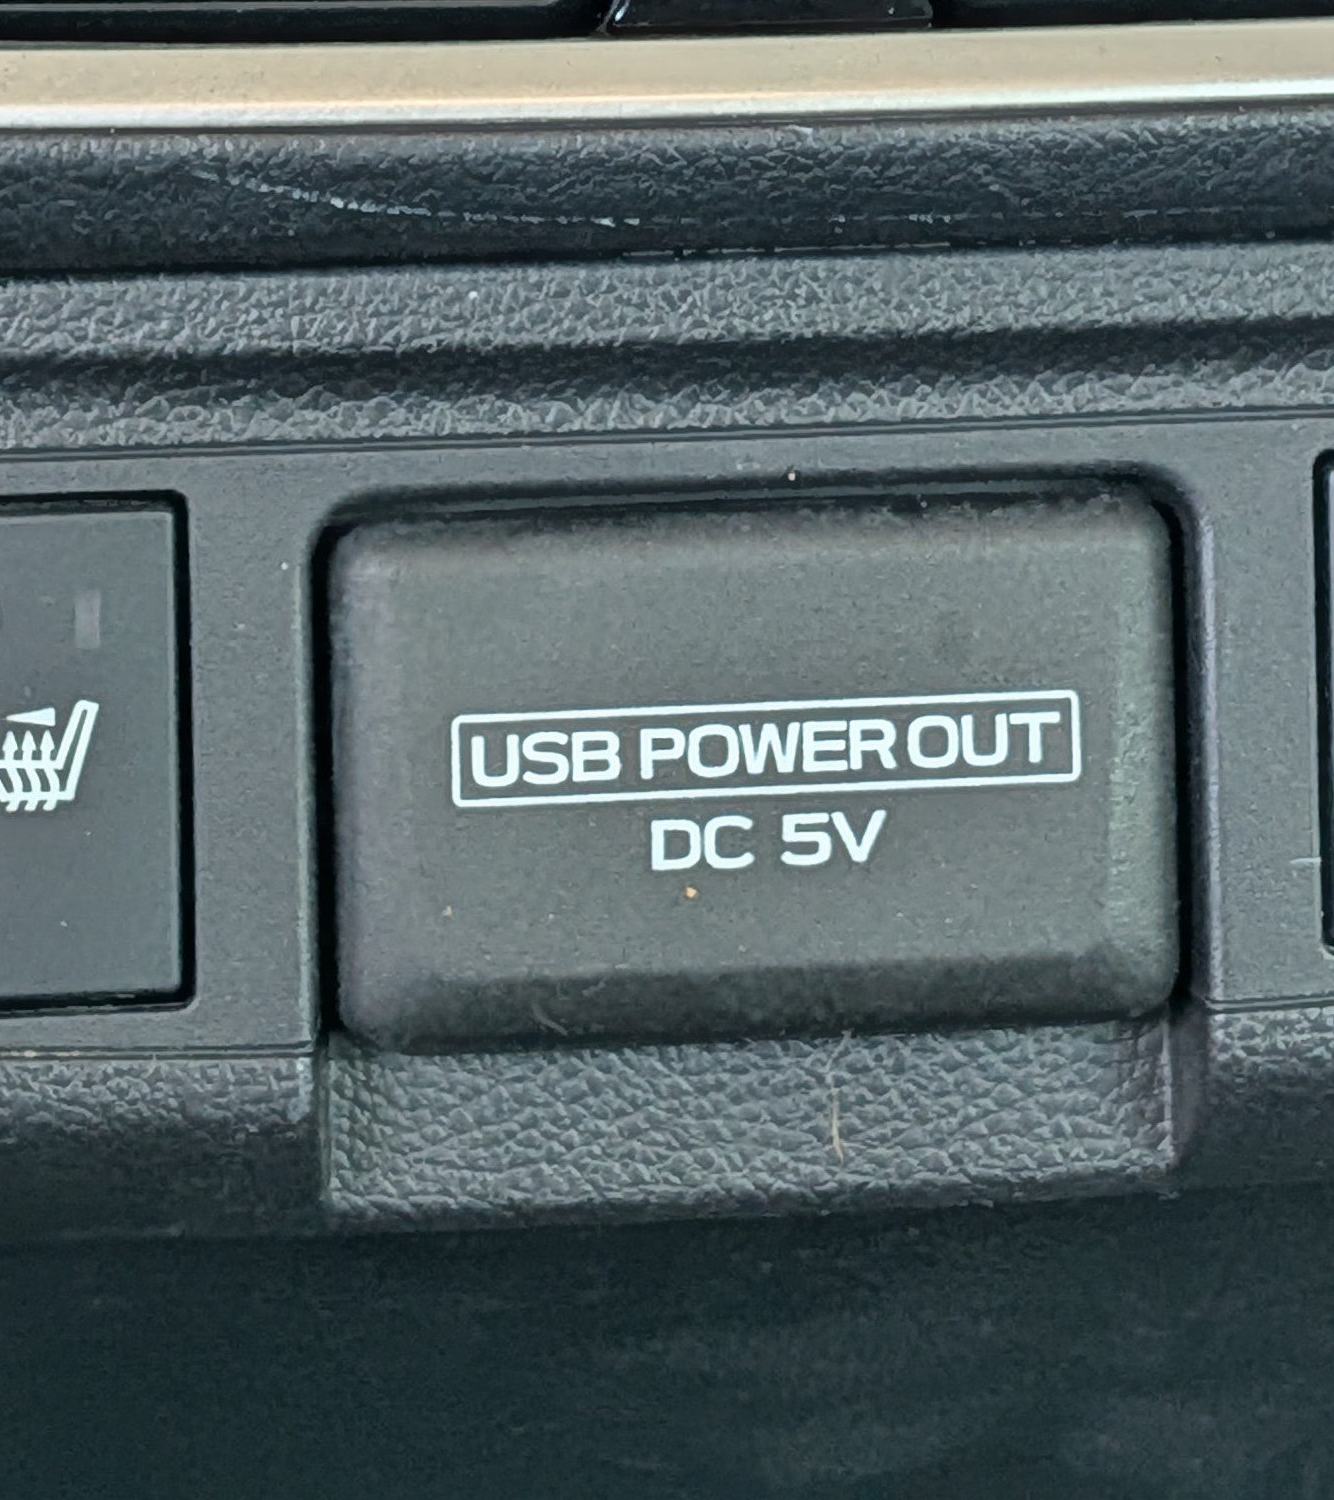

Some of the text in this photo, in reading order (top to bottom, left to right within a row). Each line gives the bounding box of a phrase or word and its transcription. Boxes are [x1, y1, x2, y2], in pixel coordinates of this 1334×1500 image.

[470, 710, 1061, 788] USB POWER OUT
[650, 809, 887, 871] DC 5V
